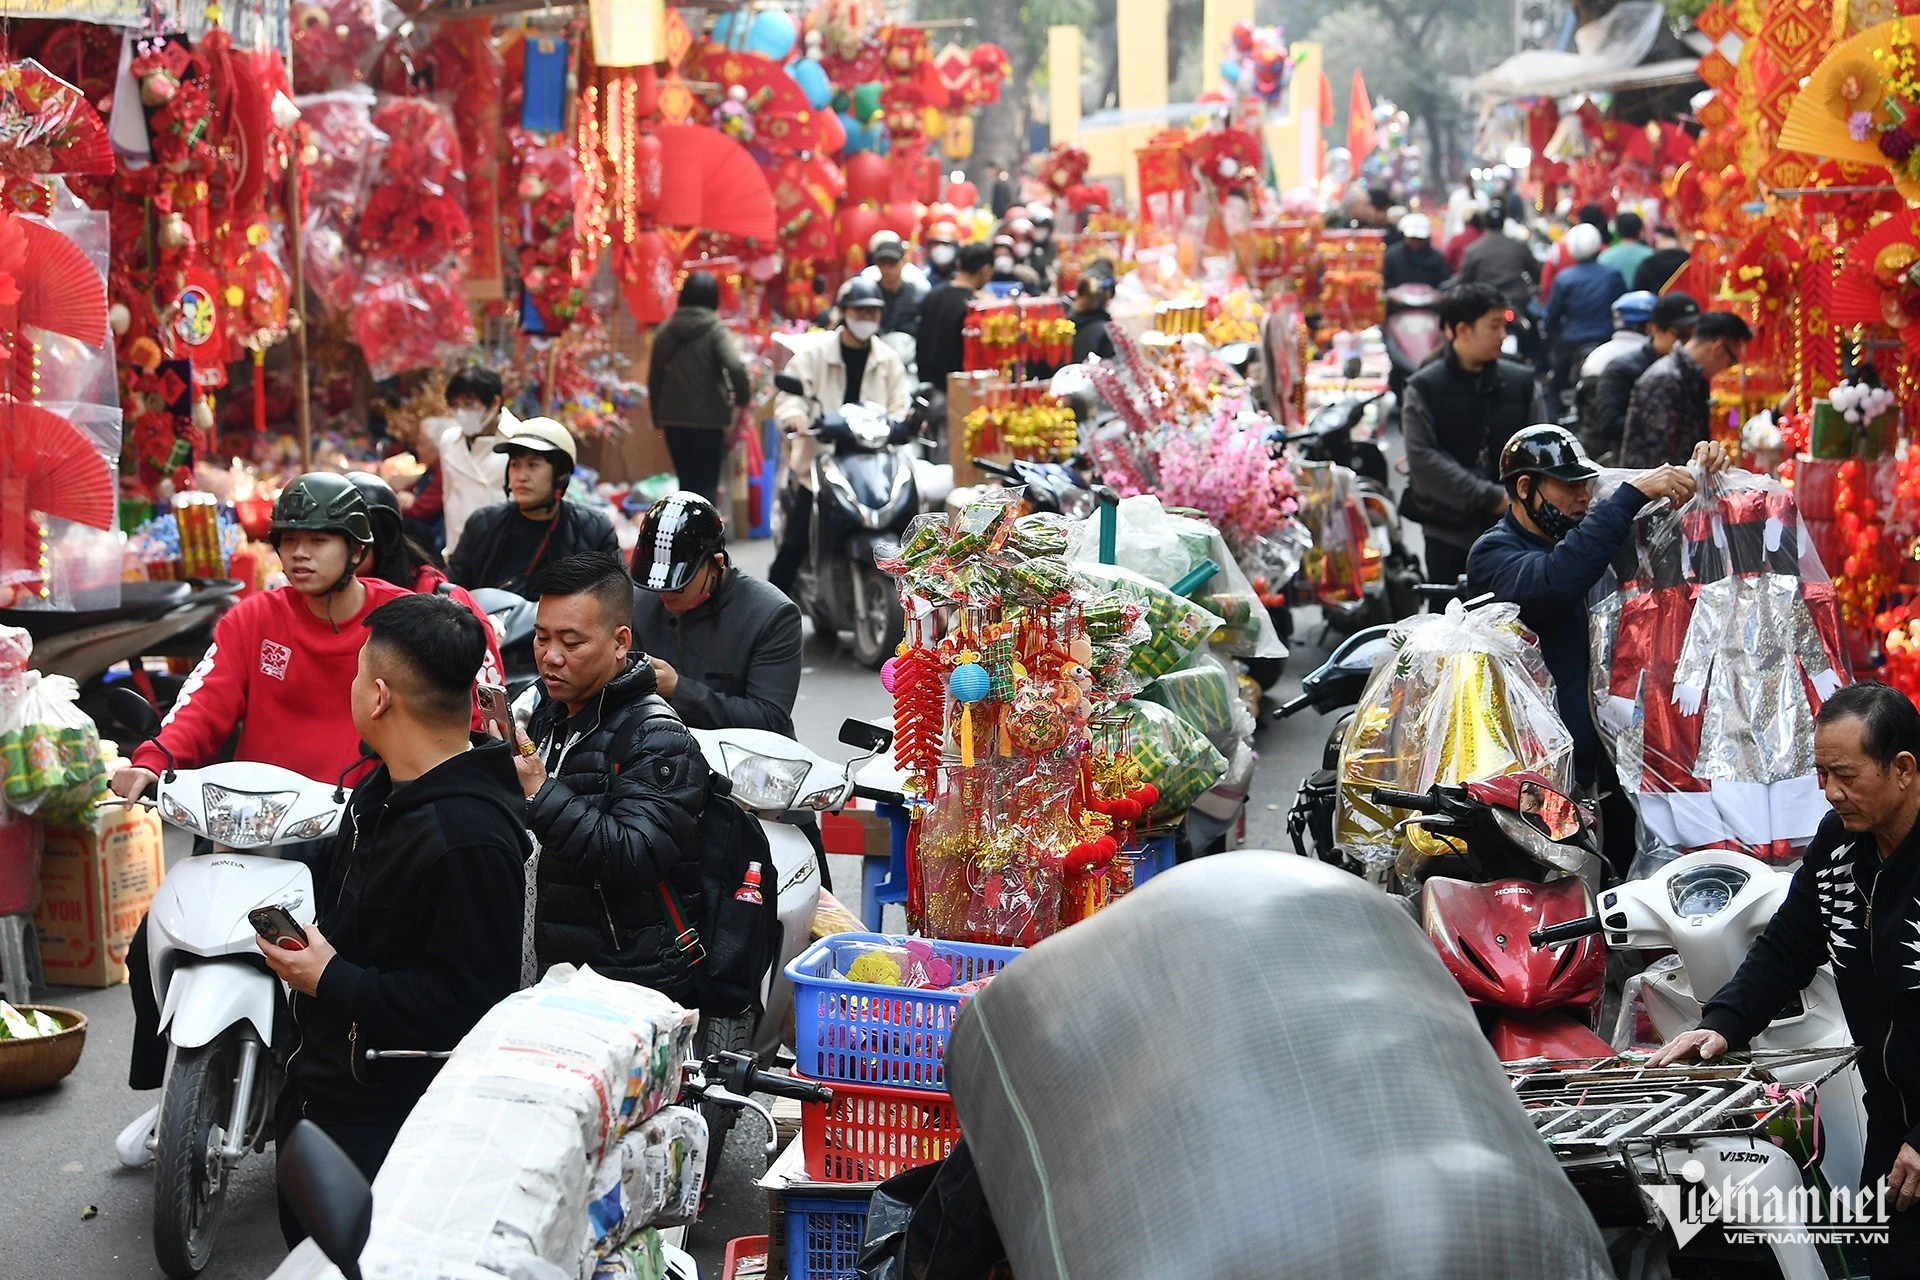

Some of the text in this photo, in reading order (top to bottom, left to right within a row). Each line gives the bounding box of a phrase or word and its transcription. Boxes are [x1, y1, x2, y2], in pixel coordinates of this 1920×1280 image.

[210, 860, 245, 869] HONDA
[1494, 887, 1533, 897] HONDA
[1719, 1150, 1770, 1165] VISION
